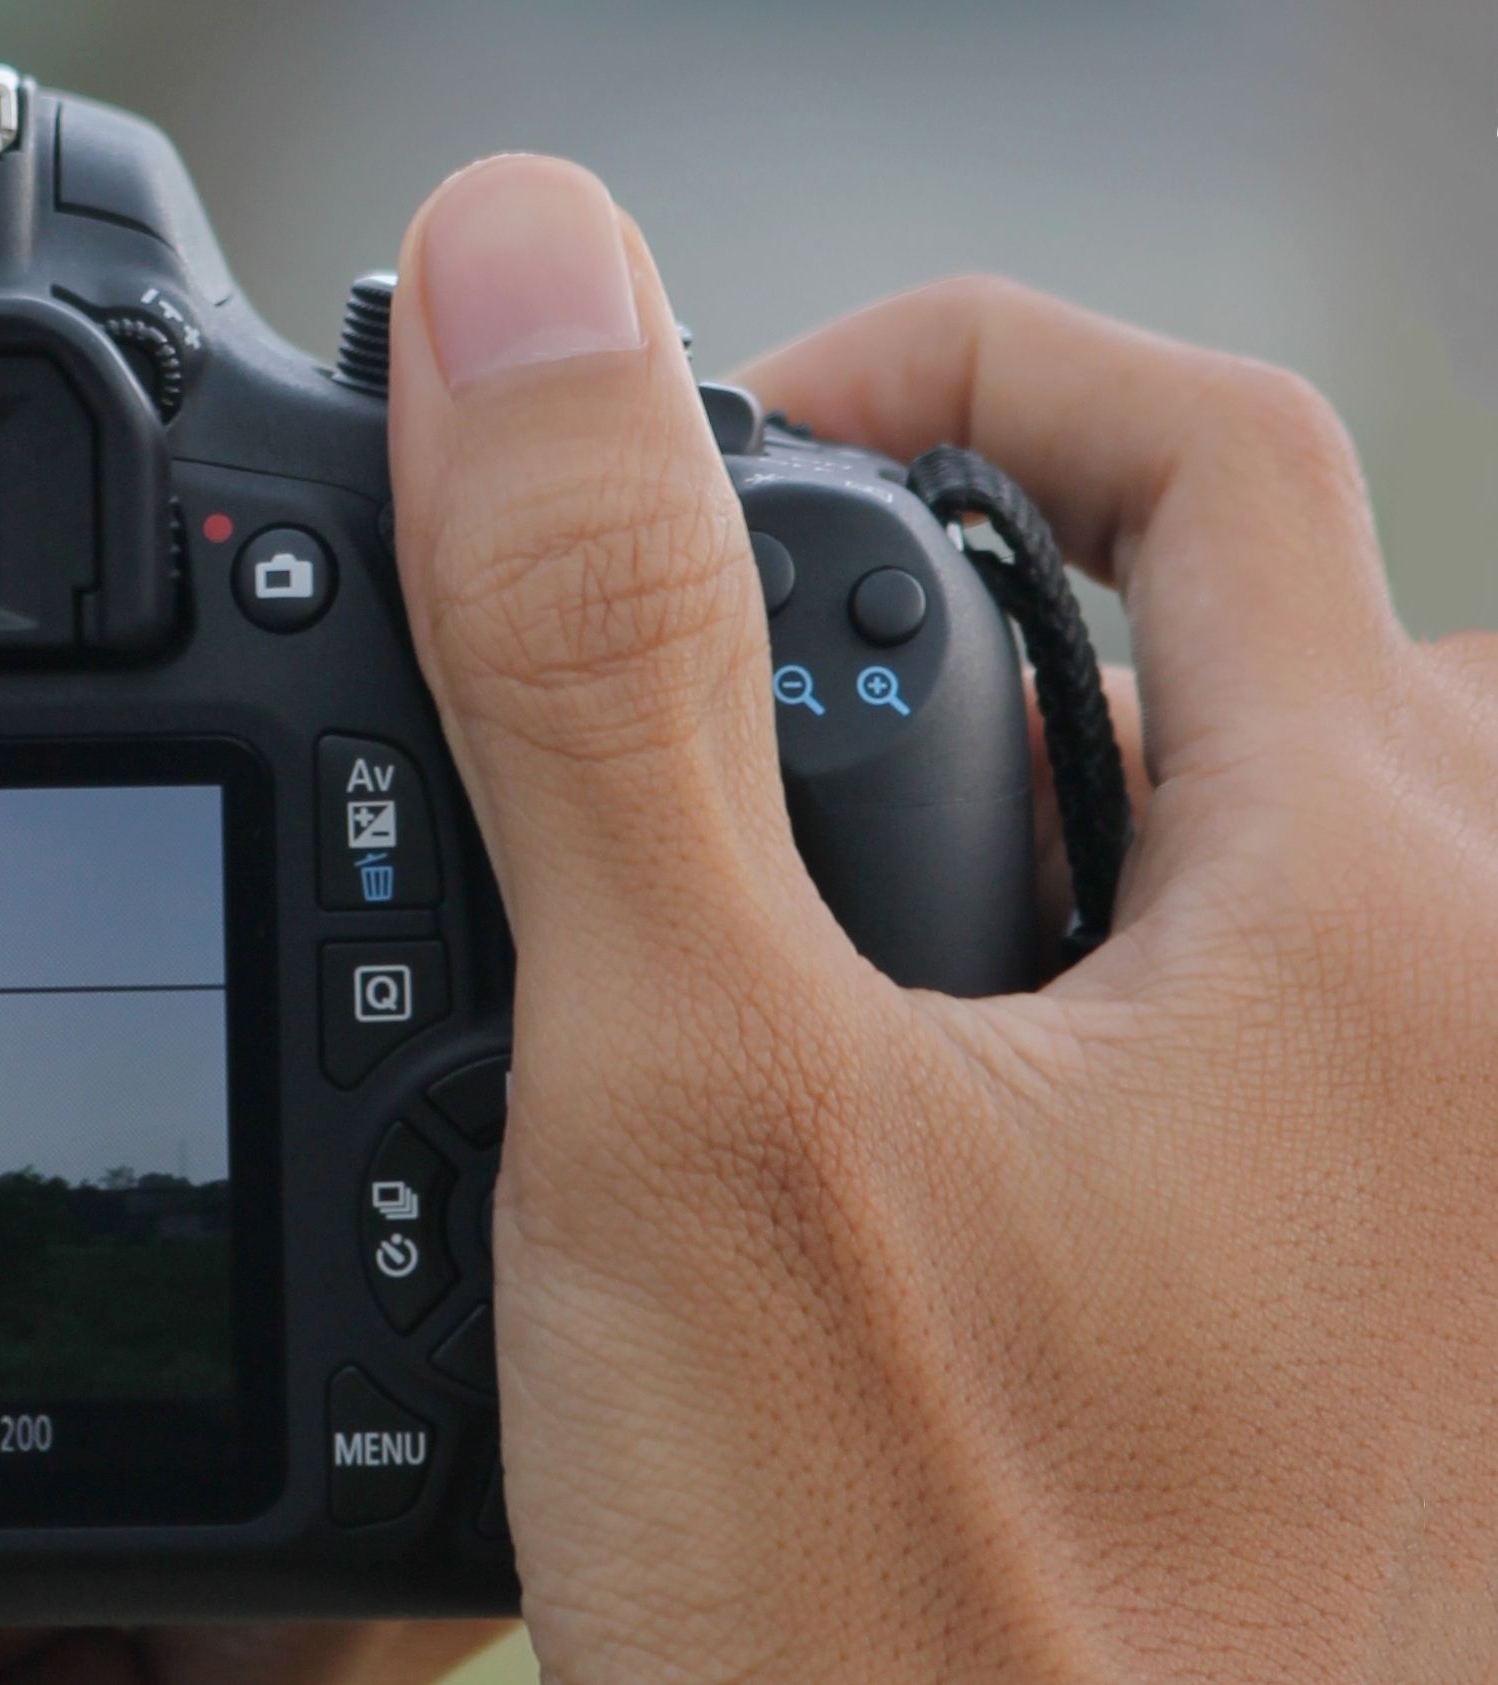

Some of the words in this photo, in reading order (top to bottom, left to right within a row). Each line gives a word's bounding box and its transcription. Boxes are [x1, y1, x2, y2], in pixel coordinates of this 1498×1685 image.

[346, 758, 395, 793] Av
[365, 975, 398, 1011] Q
[0, 1414, 53, 1453] 200
[334, 1432, 426, 1467] MENU
